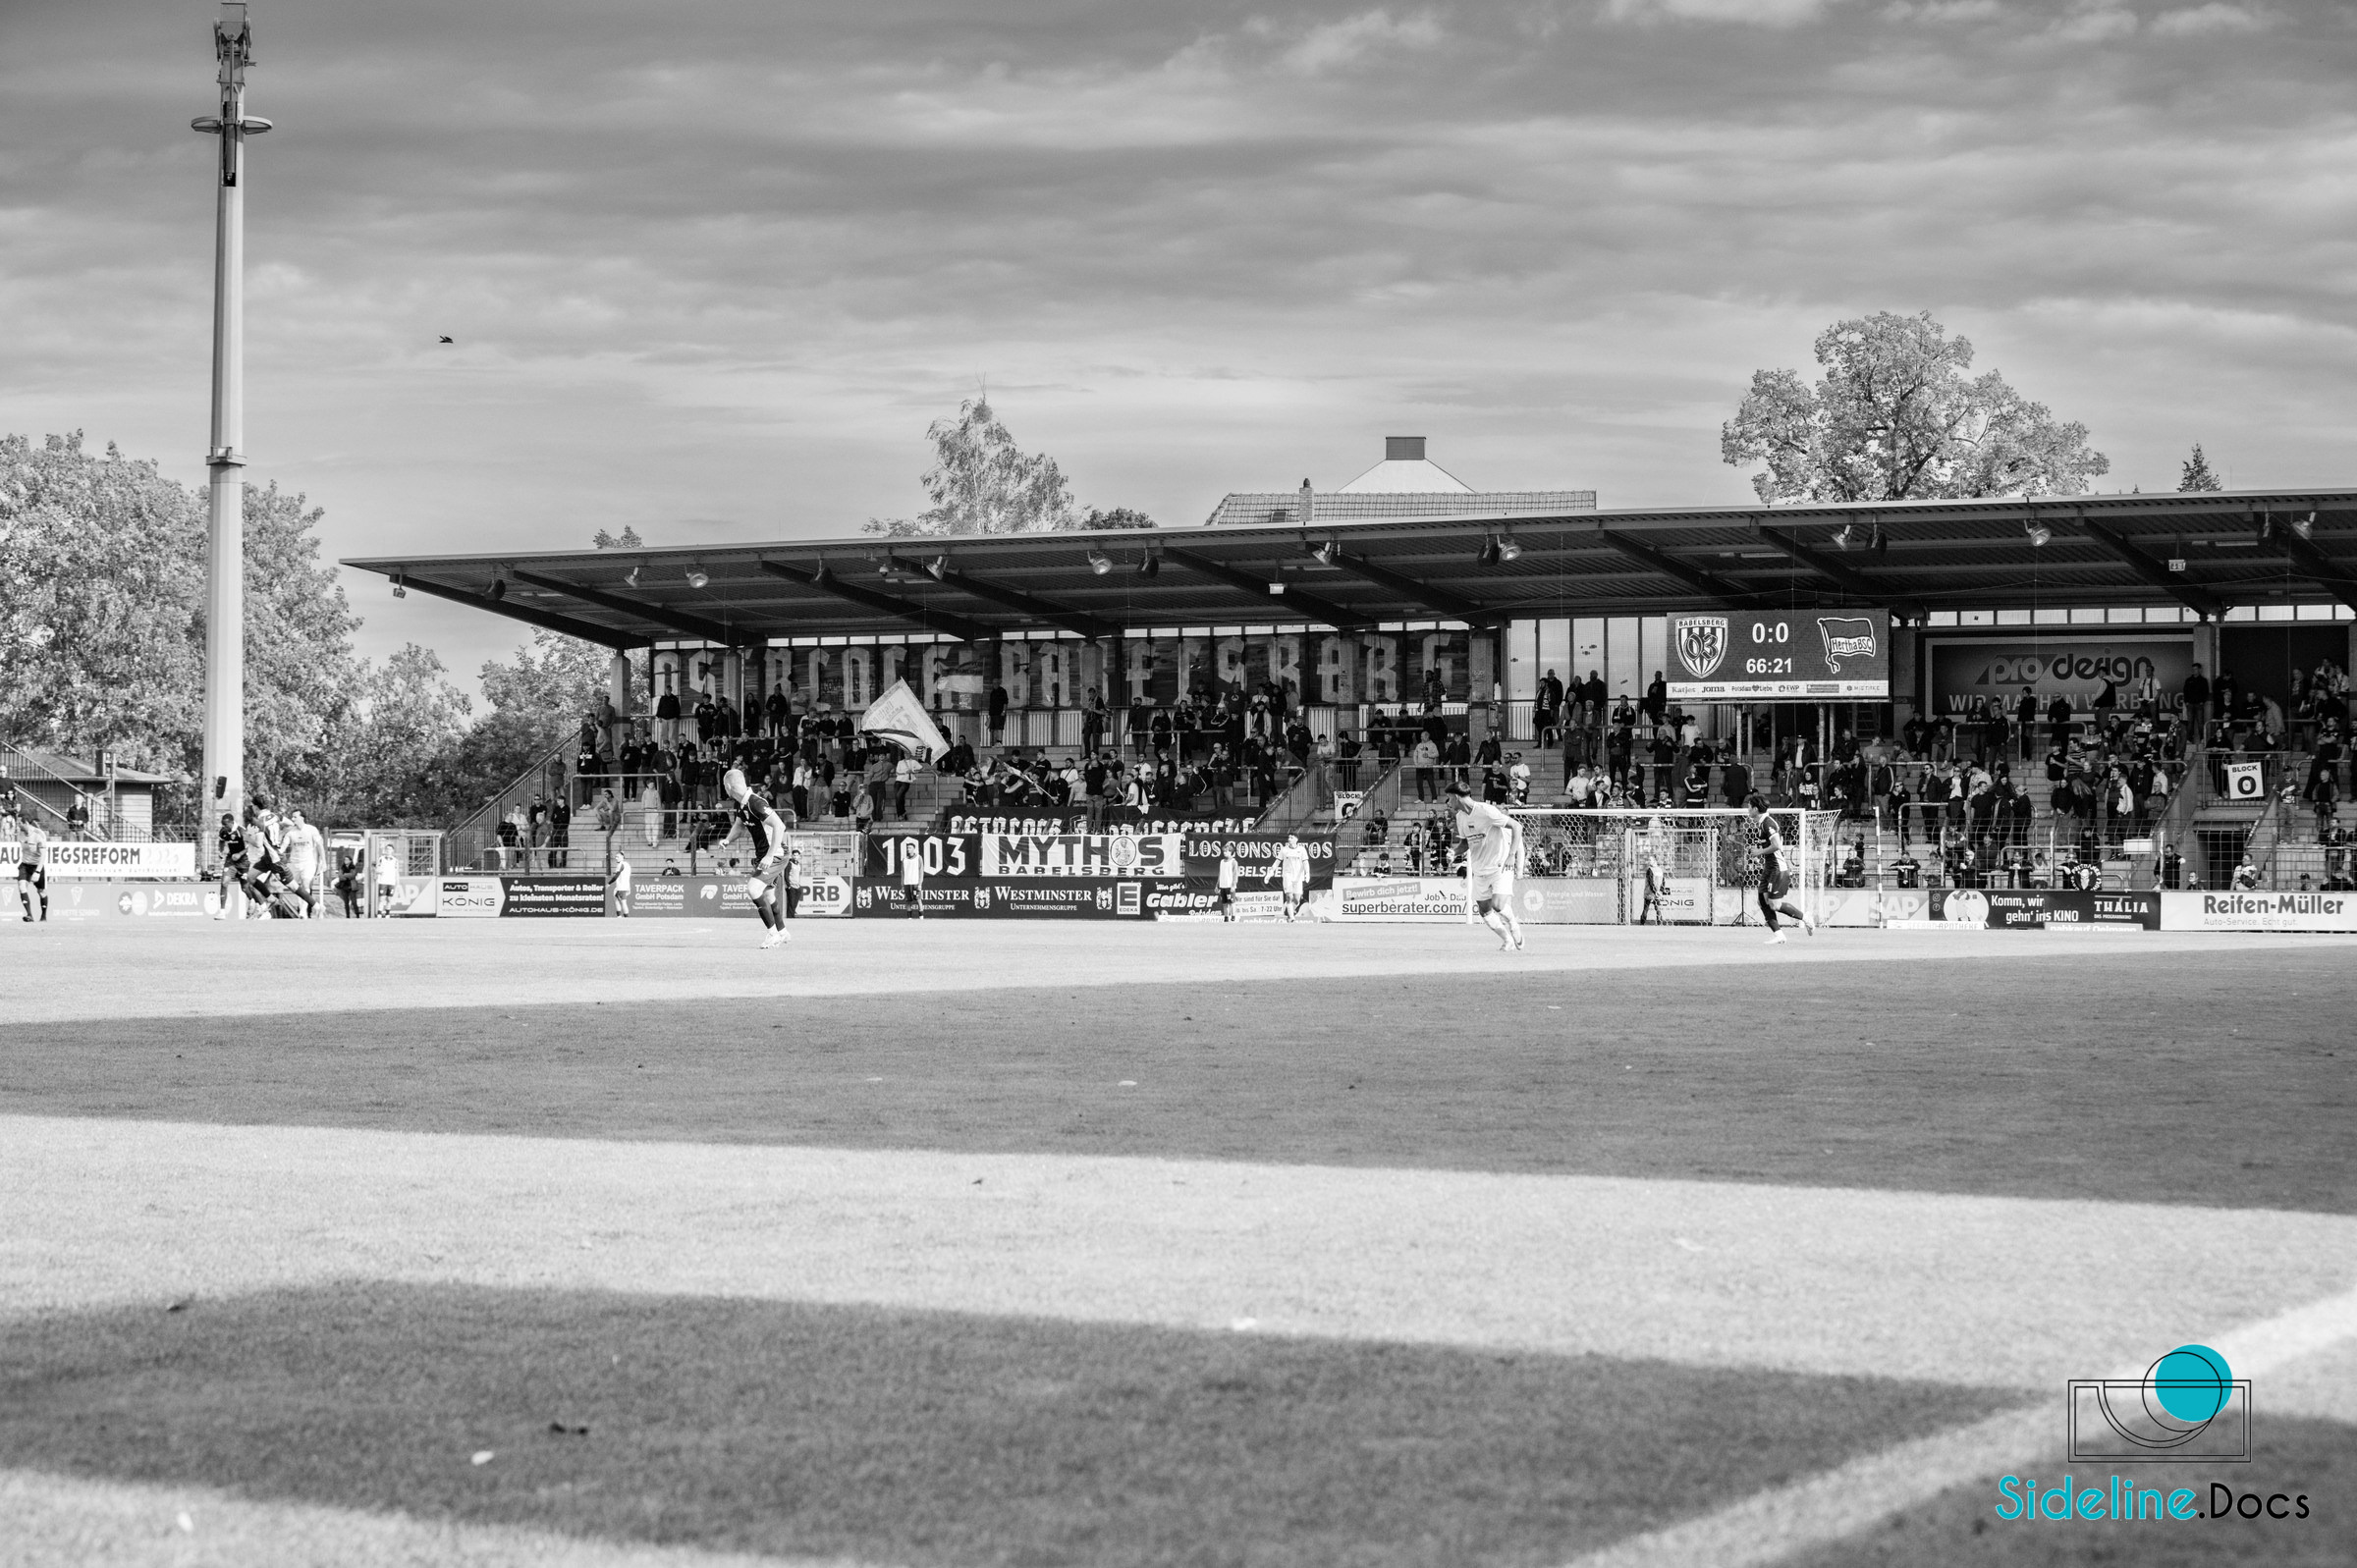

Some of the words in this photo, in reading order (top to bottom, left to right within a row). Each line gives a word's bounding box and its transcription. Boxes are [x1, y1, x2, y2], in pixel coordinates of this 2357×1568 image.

[1752, 622, 1789, 644] 0:0
[1683, 632, 1720, 662] 03
[1745, 657, 1792, 674] 66:21
[1988, 656, 2045, 685] pro
[2052, 647, 2154, 687] design
[2231, 764, 2258, 774] BLOCK
[2237, 775, 2257, 795] O
[0, 846, 141, 865] AUIEGSREFORM
[998, 835, 1165, 867] MYTHOS
[1188, 840, 1222, 858] LOS
[998, 865, 1165, 877] BABELSBERG
[391, 884, 419, 906] AP
[509, 884, 533, 892] Autos,
[533, 884, 576, 893] Transporter
[634, 884, 685, 892] TAVERPACK
[798, 885, 841, 901] PRB
[1345, 888, 1376, 899] Bewirb
[1377, 886, 1396, 896] dich
[1397, 884, 1418, 895] jetzt!
[166, 892, 198, 906] DEKRA
[442, 894, 495, 906] KÖNIG
[1146, 892, 1219, 908] Gabler
[1424, 892, 1441, 901] Job
[1991, 894, 2026, 908] Komm,
[2027, 893, 2045, 907] wir
[2203, 894, 2344, 915] Reifen-Müller
[1869, 895, 1920, 921] SAP
[2035, 909, 2052, 922] ins
[2054, 909, 2079, 922] KINO
[2203, 917, 2260, 926] Auto-Service.
[2262, 917, 2281, 926] Echt
[2282, 917, 2298, 927] gut.
